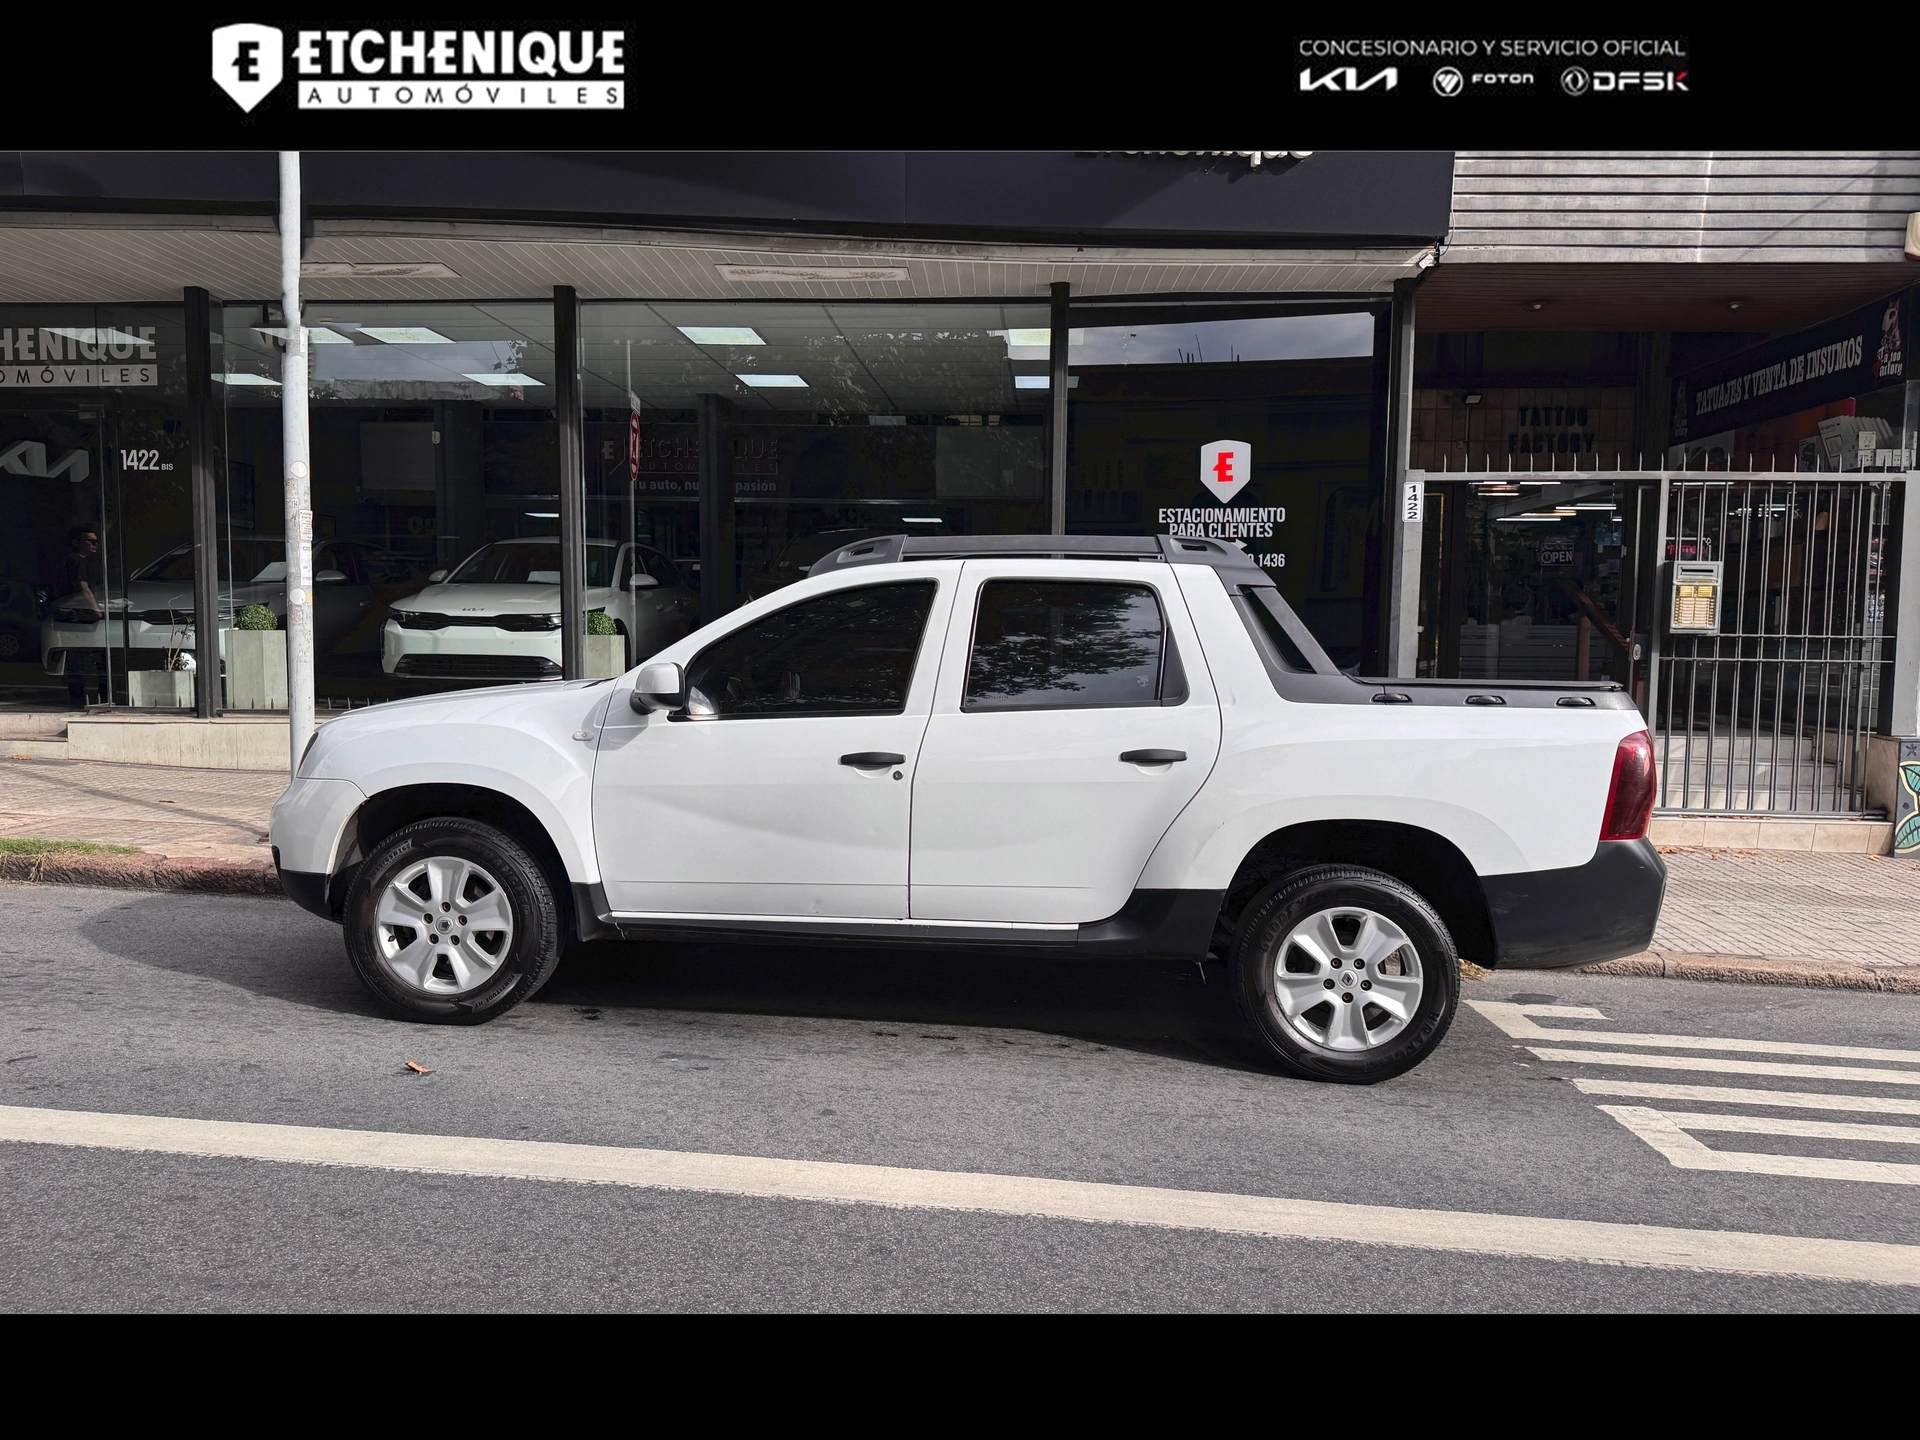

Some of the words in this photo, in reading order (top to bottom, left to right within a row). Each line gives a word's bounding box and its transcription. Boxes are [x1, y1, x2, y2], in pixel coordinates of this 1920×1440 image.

[1695, 377, 1742, 416] TATUAJES
[1743, 374, 1752, 401] Y
[1752, 360, 1788, 398] VENTA
[1788, 355, 1805, 386] DE
[1805, 335, 1863, 380] INSUMOS
[1518, 405, 1588, 427] TATTOO
[1508, 433, 1596, 454] FACTORY
[120, 449, 160, 471] 1422
[161, 463, 174, 471] BIS
[649, 481, 681, 493] auto,
[735, 479, 777, 494] pasión
[1407, 484, 1419, 520] 1422
[1158, 507, 1286, 523] ESTACIONAMIENTO
[1169, 523, 1206, 537] PARA
[1208, 522, 1273, 538] CLIENTES
[1258, 553, 1286, 568] 1436
[1541, 551, 1573, 564] OPEN
